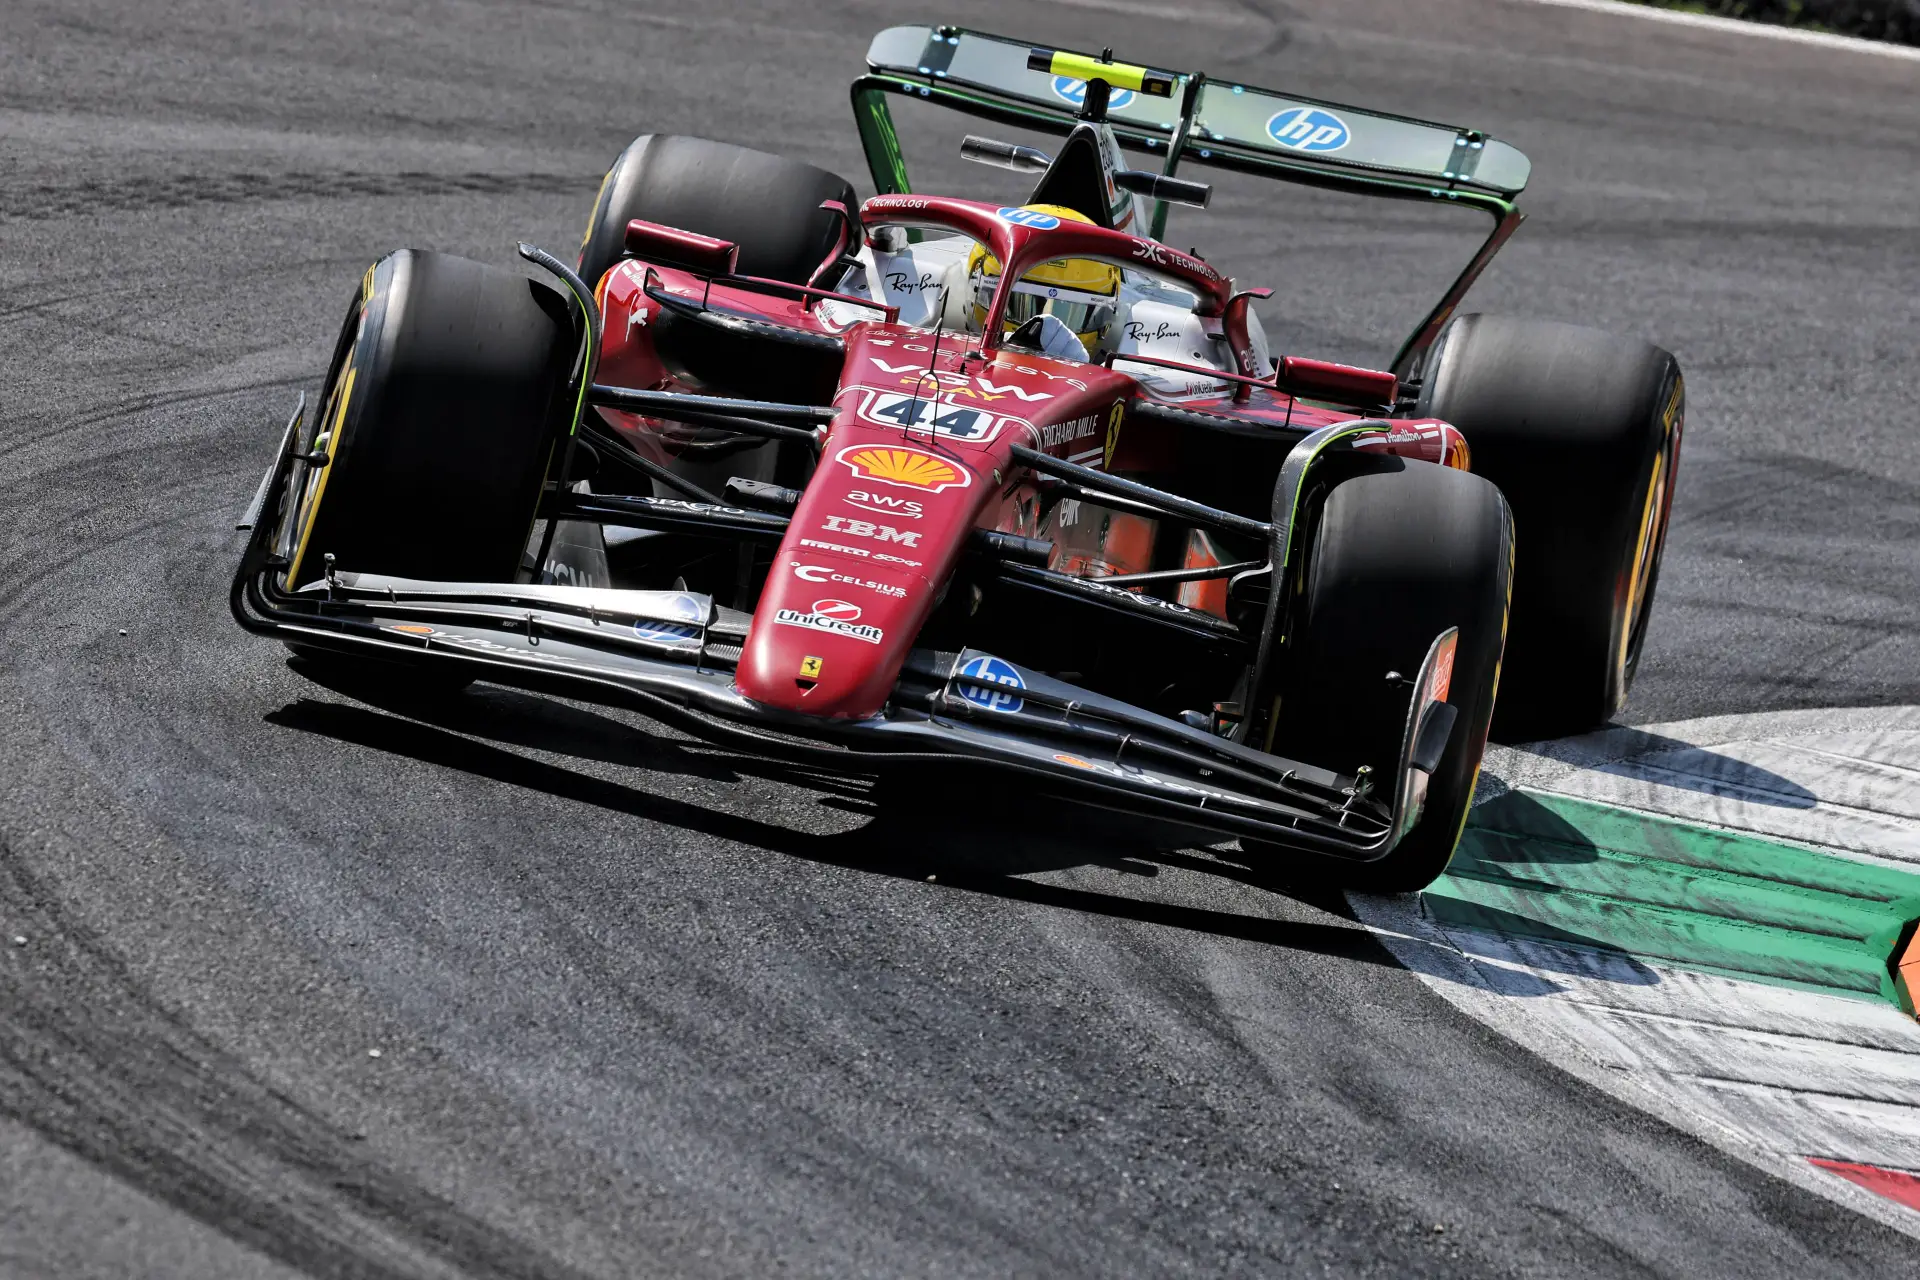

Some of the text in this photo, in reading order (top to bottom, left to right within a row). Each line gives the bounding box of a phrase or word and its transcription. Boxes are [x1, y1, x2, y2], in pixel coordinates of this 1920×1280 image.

[1271, 107, 1346, 151] hp
[872, 199, 930, 209] TECHNOLOGY
[1132, 238, 1167, 265] DXC
[885, 272, 943, 294] Ray-Ban
[1124, 321, 1181, 343] Ray-Ban
[868, 358, 1056, 402] VGW
[902, 344, 1088, 392] GEESYS
[900, 376, 1007, 402] PLAY
[876, 399, 983, 437] 44
[1042, 414, 1099, 448] RICHARD MILLE
[1387, 428, 1422, 443] Hamilton
[847, 490, 924, 513] aws
[821, 515, 922, 548] IBM
[800, 538, 871, 557] PIRELLI
[830, 573, 906, 596] CELSIUS
[779, 609, 882, 640] UniCredit
[963, 656, 1022, 712] hp
